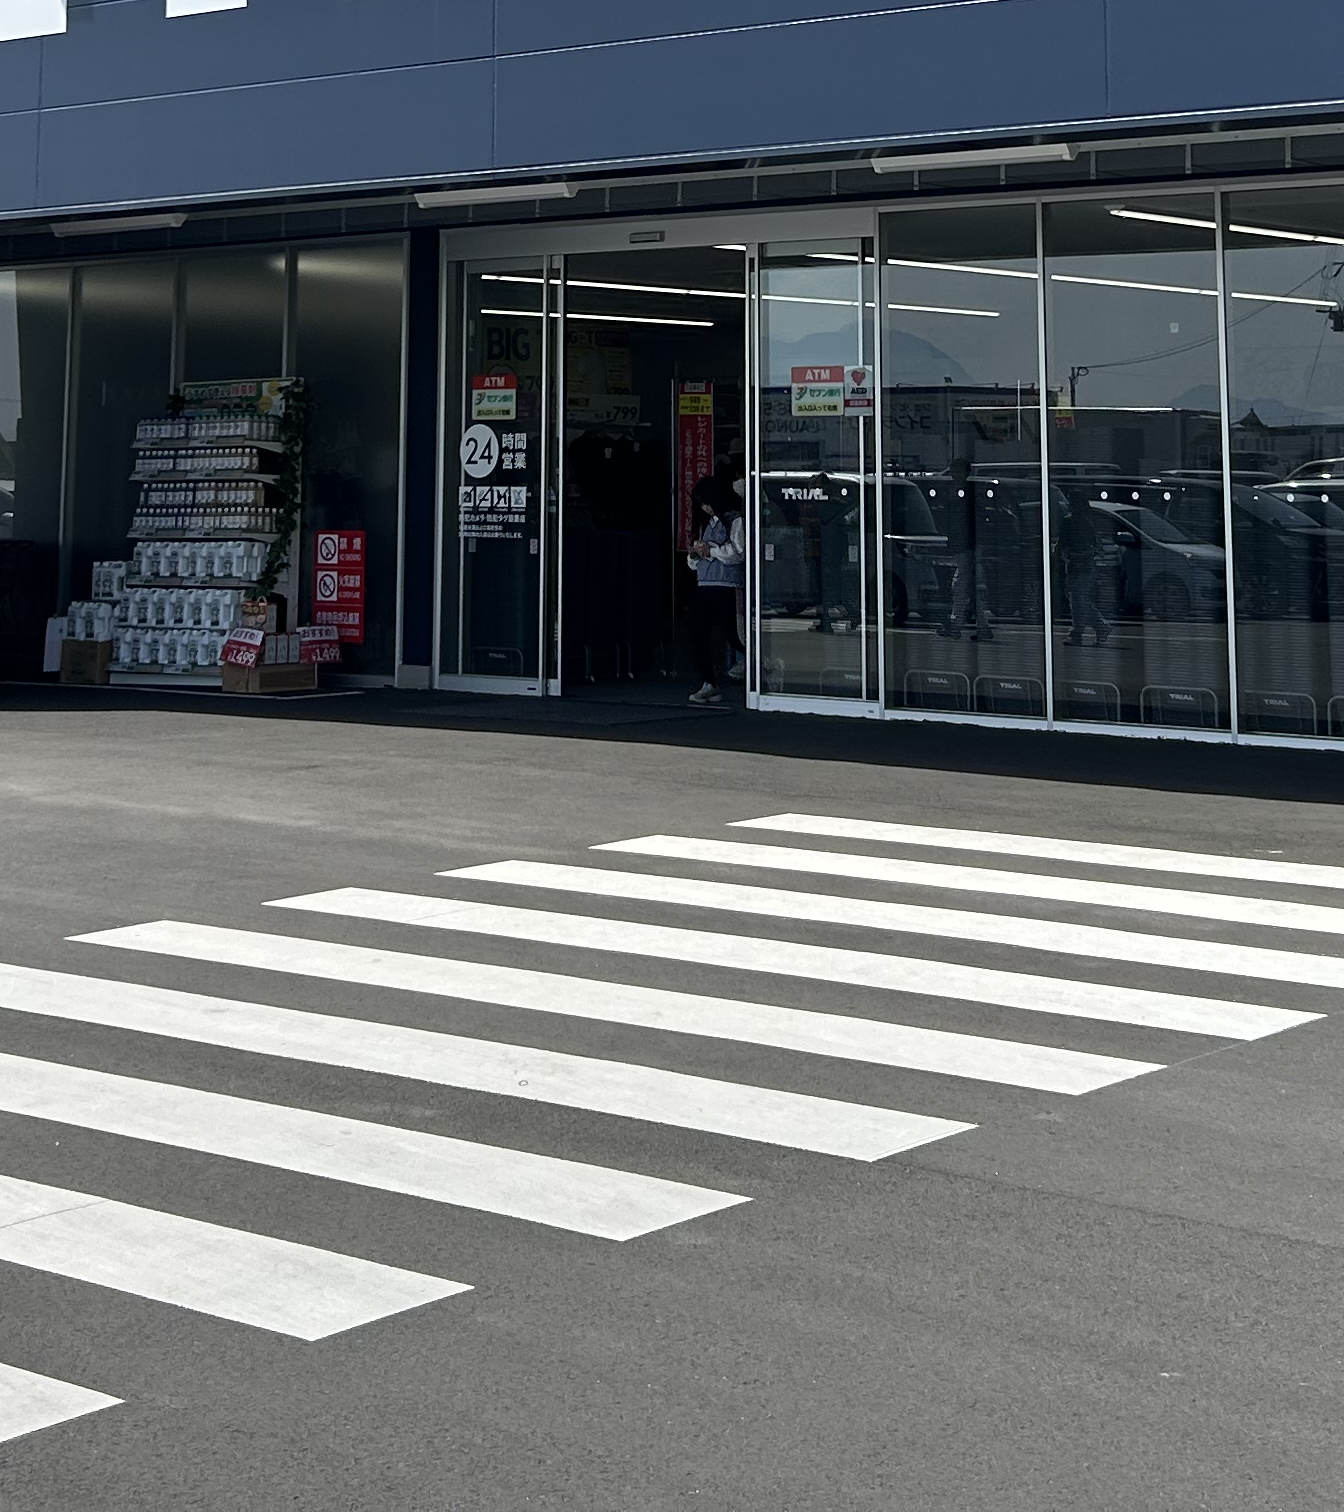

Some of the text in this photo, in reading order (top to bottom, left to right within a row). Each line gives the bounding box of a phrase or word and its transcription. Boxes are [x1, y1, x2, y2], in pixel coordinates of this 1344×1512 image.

[487, 326, 530, 361] BIG
[484, 376, 505, 387] ATM
[805, 369, 830, 380] ATM
[850, 387, 868, 395] AED
[502, 433, 527, 450] 時間
[465, 436, 493, 465] 24
[502, 452, 527, 469] 営業
[781, 487, 828, 501] TRIAL
